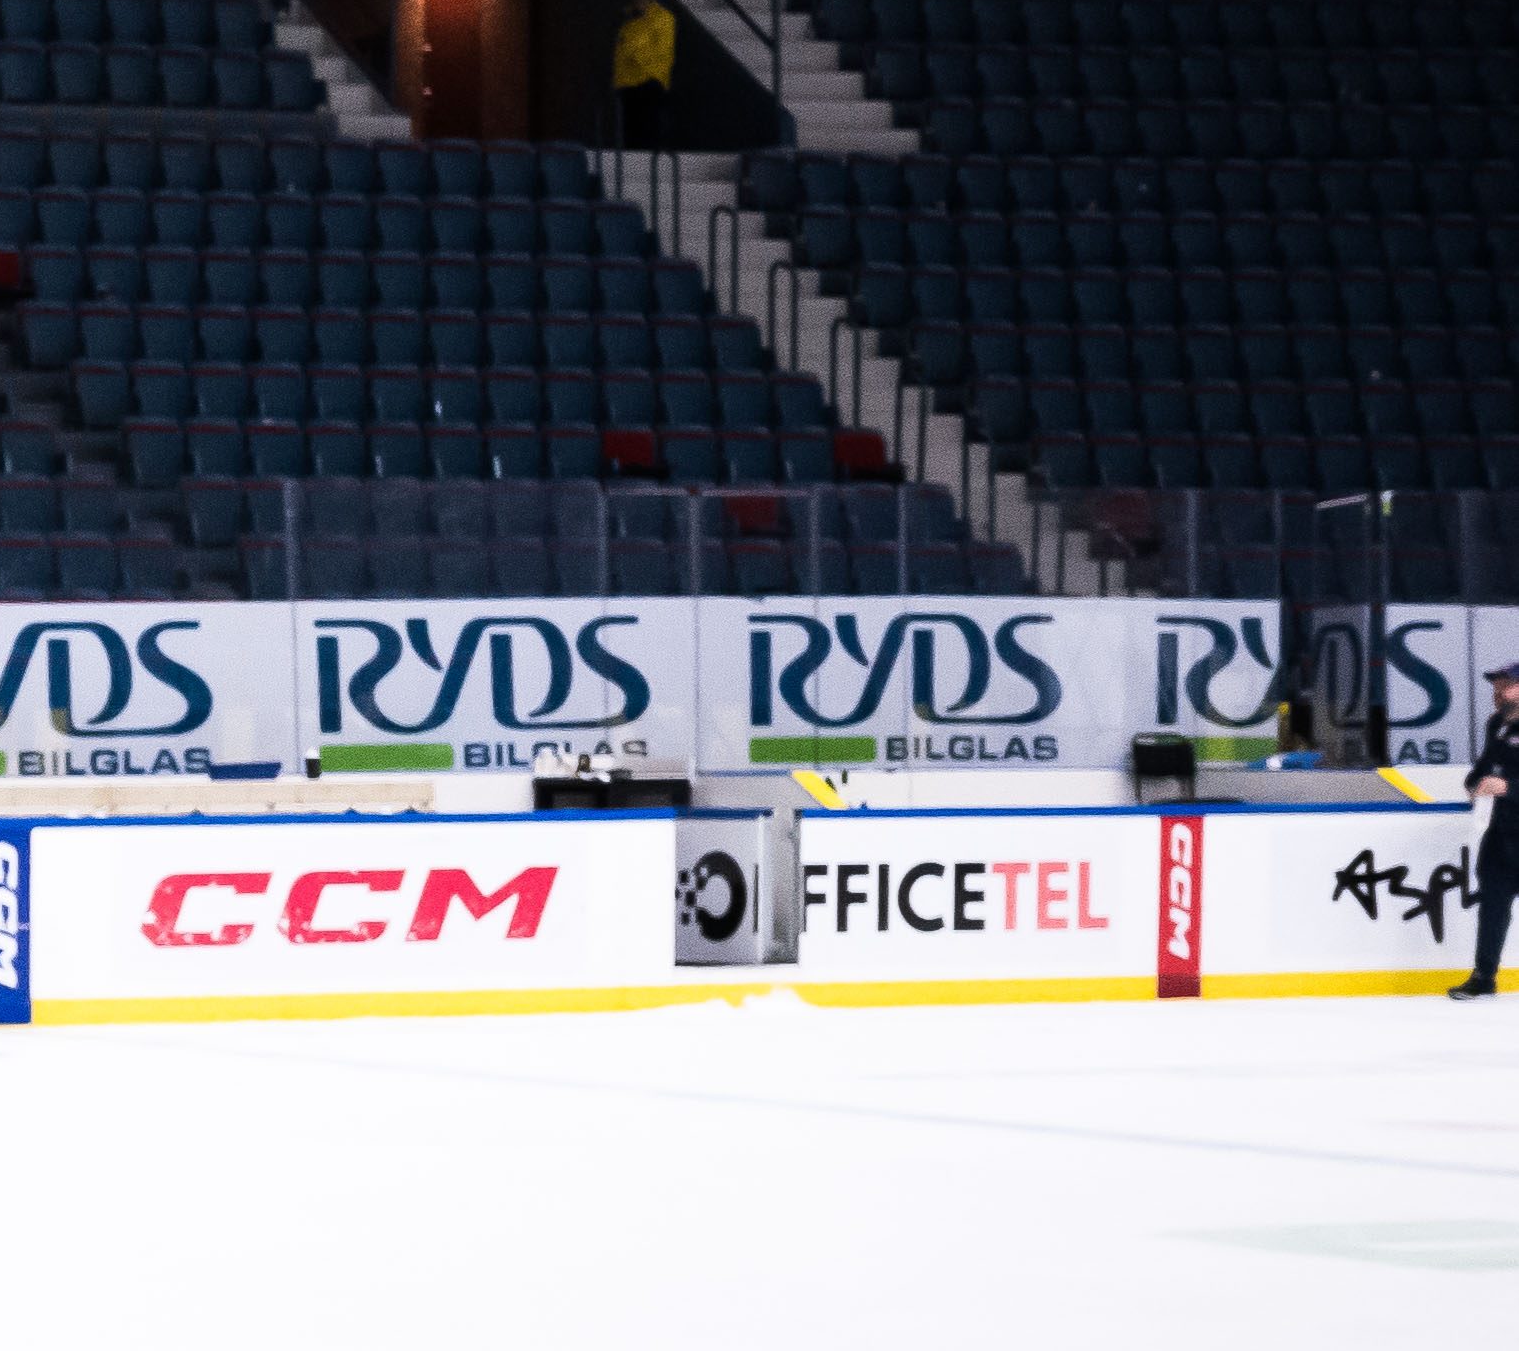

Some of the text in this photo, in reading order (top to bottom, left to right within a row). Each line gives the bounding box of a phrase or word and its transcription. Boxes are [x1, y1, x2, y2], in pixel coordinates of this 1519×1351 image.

[313, 615, 651, 735] RYDS
[746, 613, 1063, 729] RYDS
[17, 746, 214, 777] BILGLAS
[885, 735, 1060, 762] BILGLAS
[139, 865, 560, 948] CCM
[1168, 822, 1194, 960] CCM
